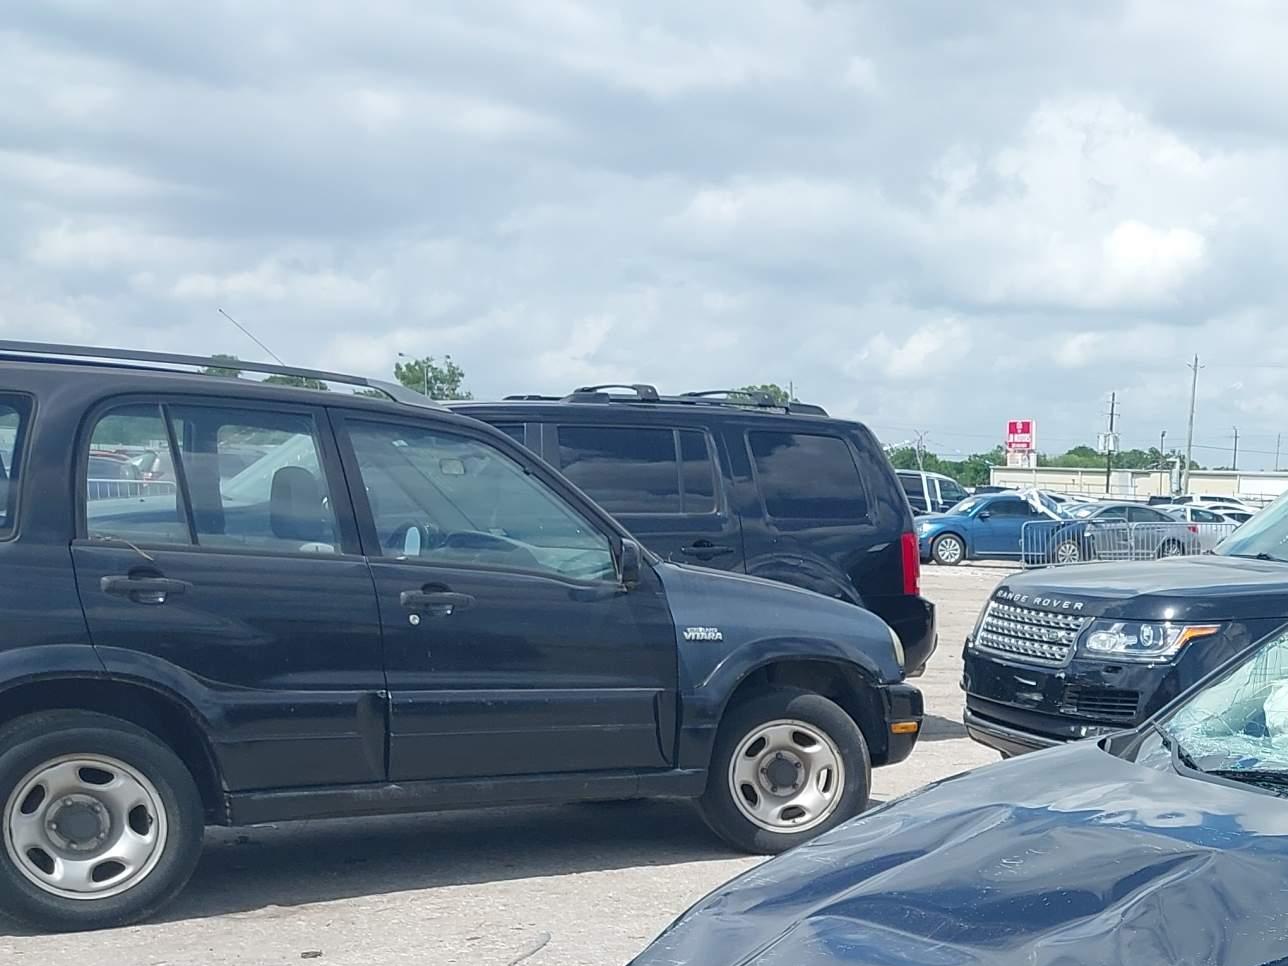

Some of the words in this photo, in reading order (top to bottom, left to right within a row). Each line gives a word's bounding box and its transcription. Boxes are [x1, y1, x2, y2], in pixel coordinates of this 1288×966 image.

[996, 590, 1028, 602] RANGE
[1033, 597, 1084, 610] ROVER
[683, 631, 723, 640] VITARA
